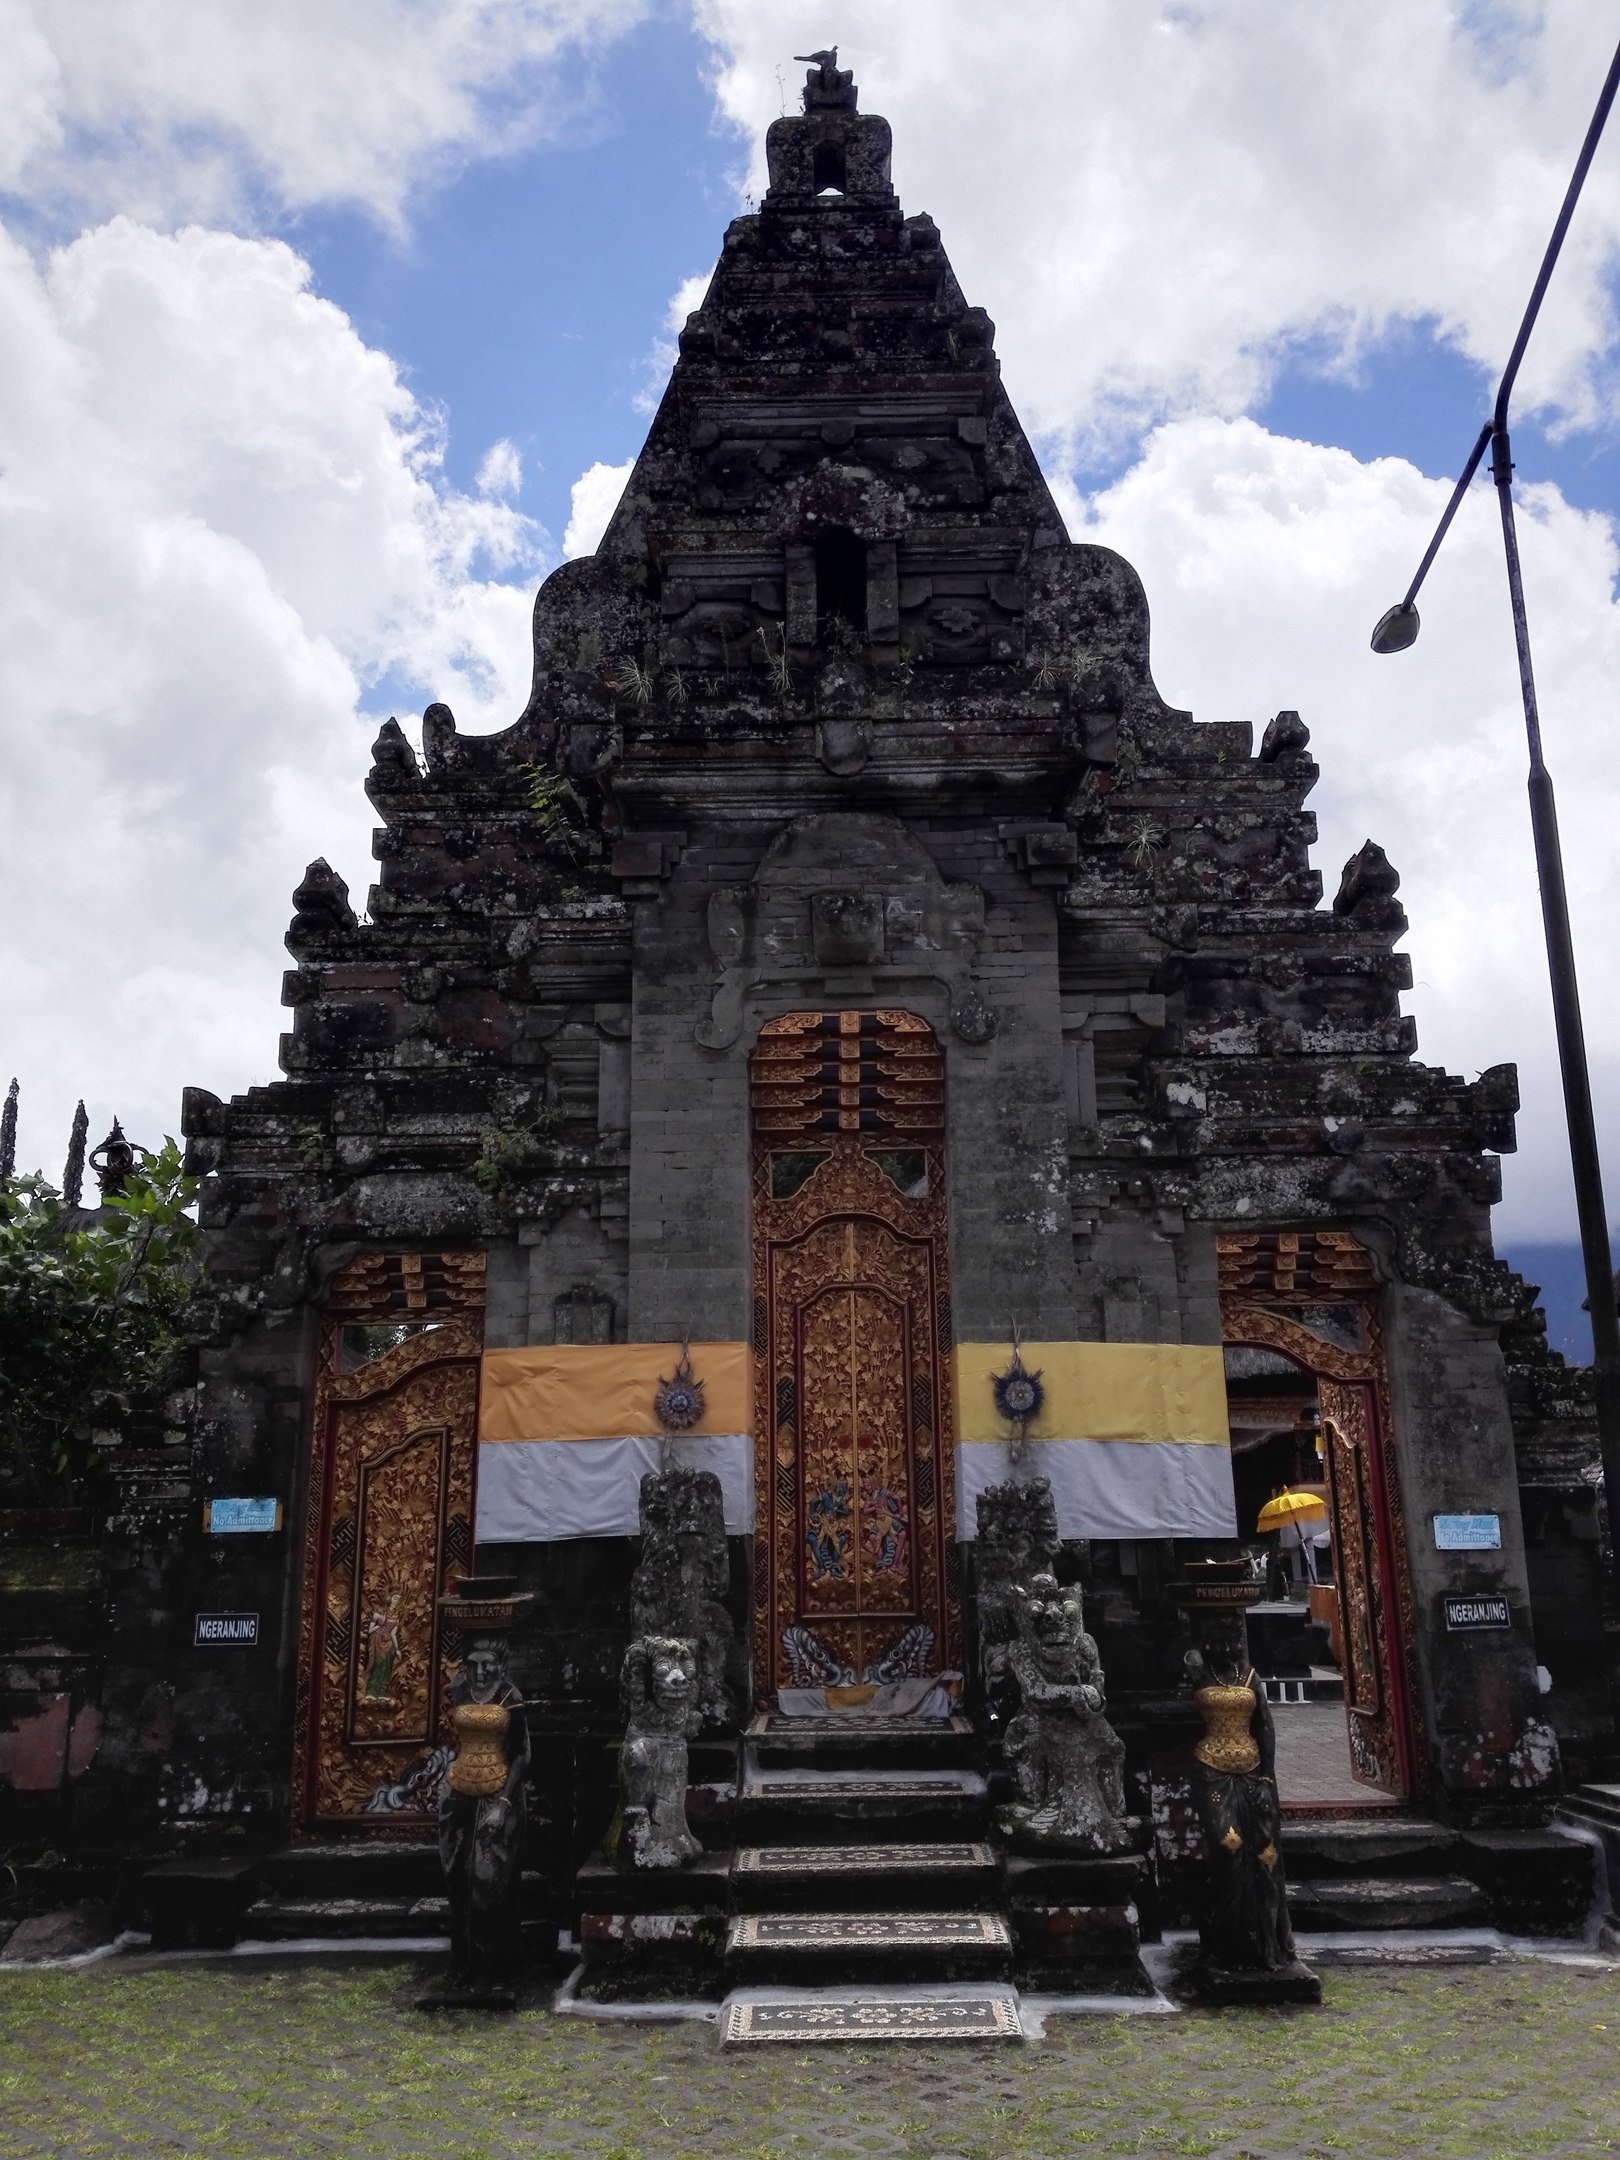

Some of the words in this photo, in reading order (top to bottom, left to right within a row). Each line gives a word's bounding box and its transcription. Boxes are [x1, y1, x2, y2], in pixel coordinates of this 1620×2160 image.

[213, 1515, 225, 1526] No
[227, 1514, 273, 1526] Admittance
[1452, 1530, 1500, 1542] Admittance
[444, 1605, 513, 1618] PENGELUKATAN
[1449, 1602, 1506, 1622] NGERANJING
[199, 1620, 255, 1638] NGERANJING
